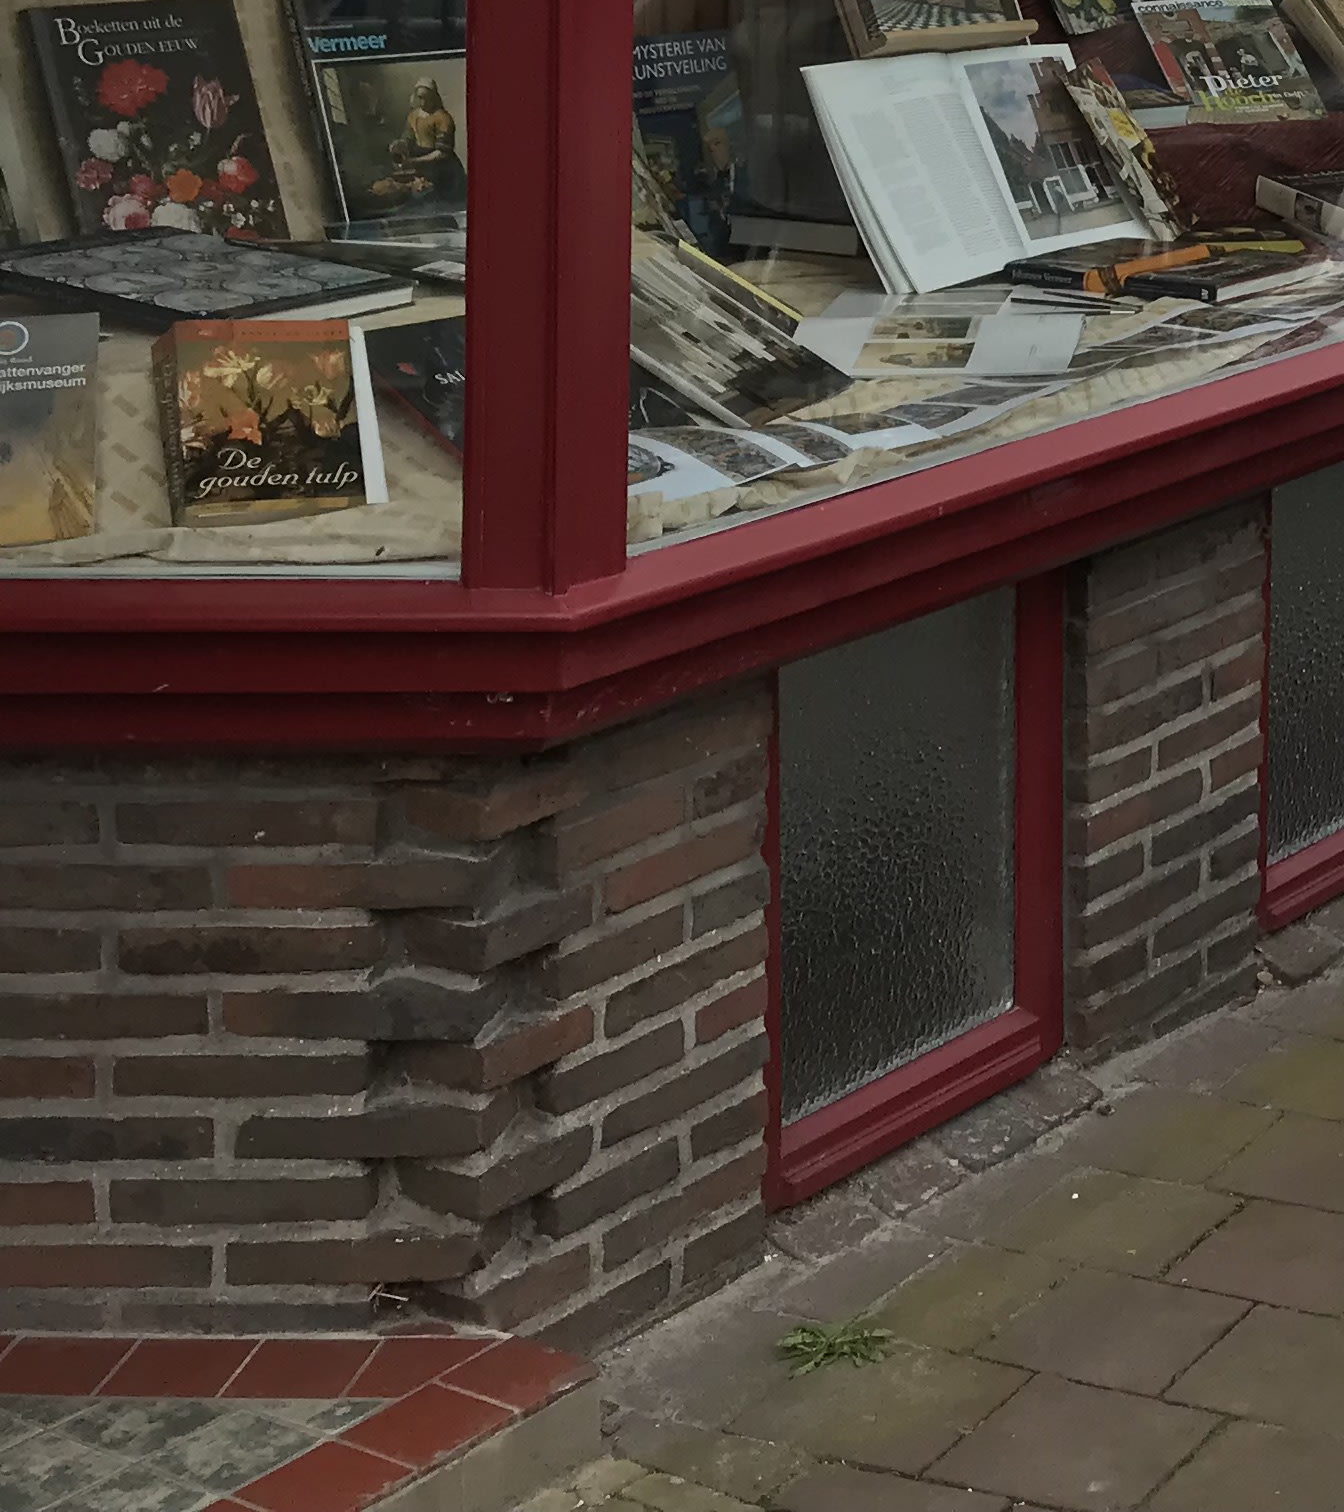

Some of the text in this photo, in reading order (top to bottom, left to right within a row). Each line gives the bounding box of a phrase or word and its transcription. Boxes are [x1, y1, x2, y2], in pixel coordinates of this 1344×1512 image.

[53, 13, 184, 46] Boeketten uit de
[306, 33, 388, 54] Vermeer
[696, 37, 727, 53] VAN
[1199, 74, 1283, 98] Pieter
[0, 363, 87, 378] attenvanger
[217, 447, 262, 471] De
[194, 461, 359, 499] gouden tulp
